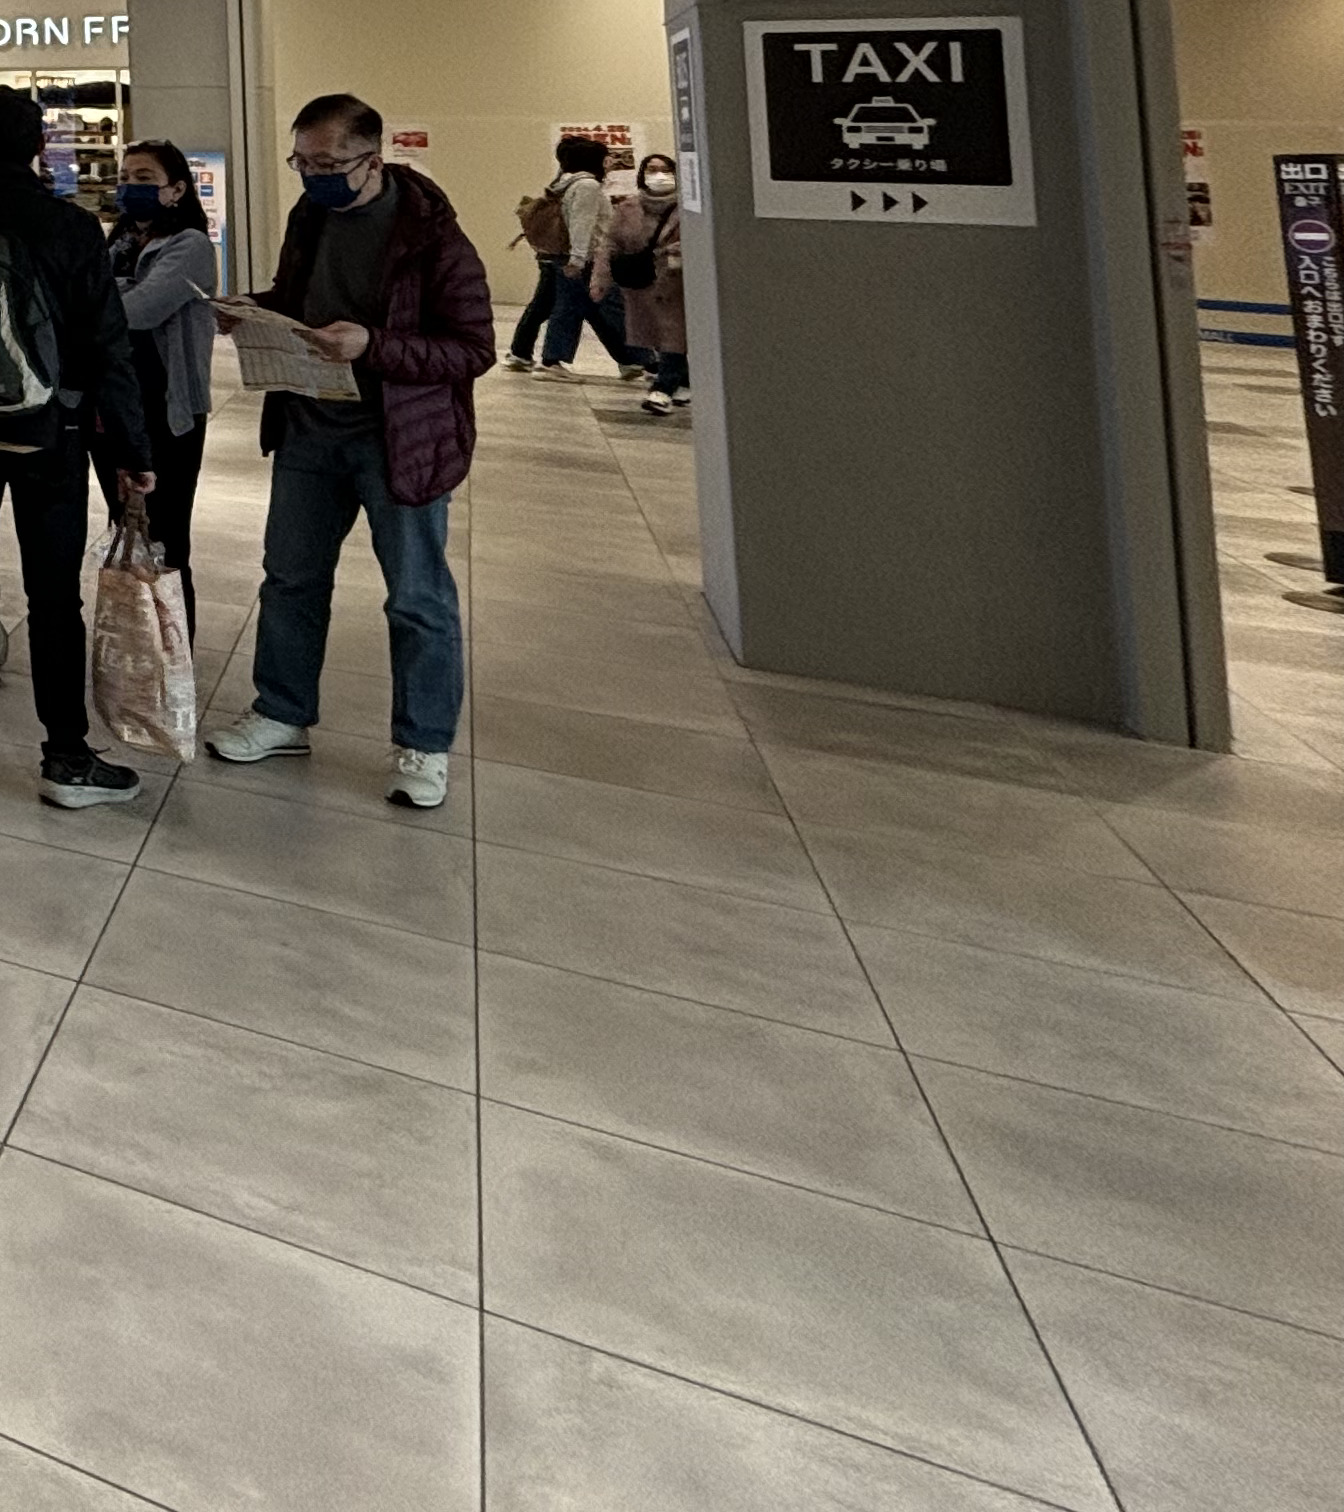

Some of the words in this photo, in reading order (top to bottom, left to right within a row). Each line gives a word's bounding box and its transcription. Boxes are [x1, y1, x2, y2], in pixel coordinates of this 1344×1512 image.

[792, 41, 965, 84] TAXI
[829, 157, 949, 173] タクシー乗り場
[1280, 162, 1329, 180] 出口
[1283, 181, 1330, 195] EXIT
